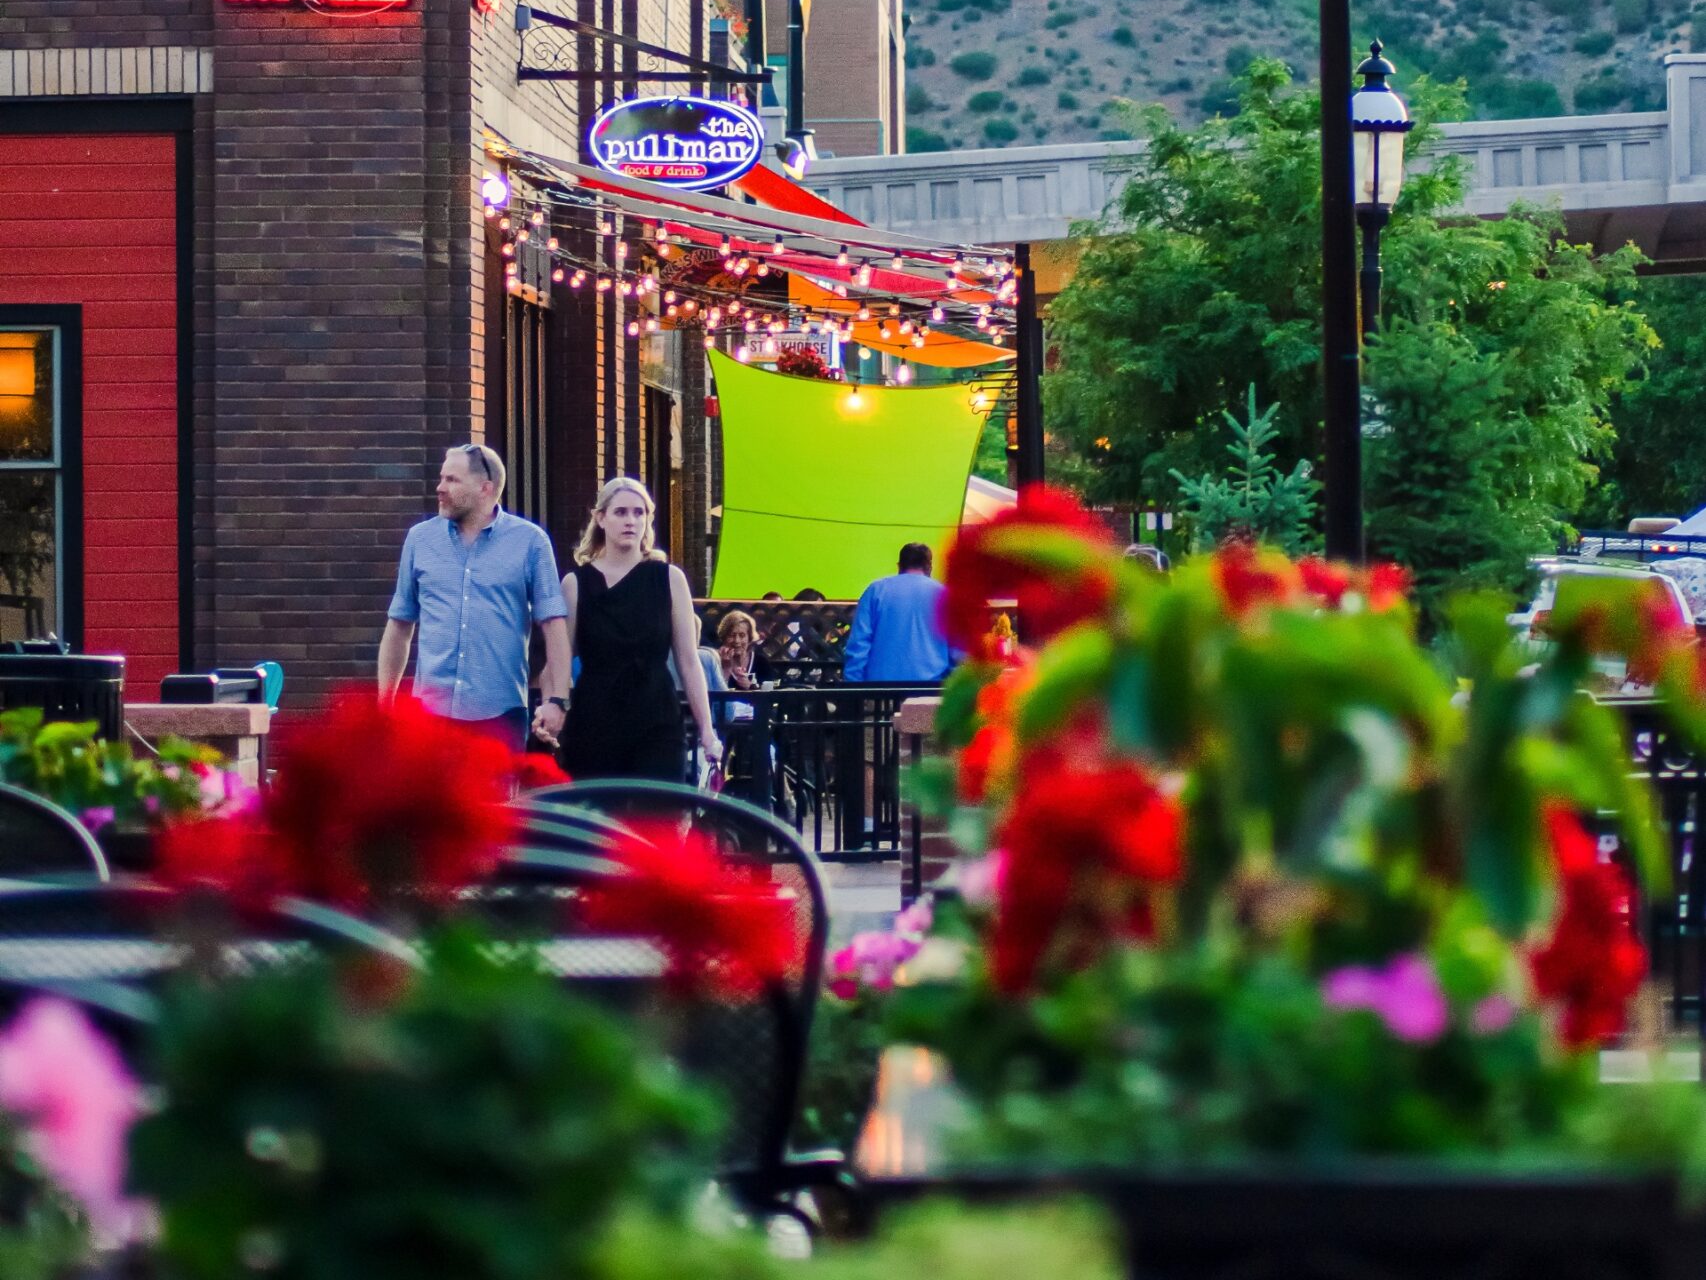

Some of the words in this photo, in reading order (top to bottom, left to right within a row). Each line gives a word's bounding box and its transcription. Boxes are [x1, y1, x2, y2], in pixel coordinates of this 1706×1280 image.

[706, 116, 752, 139] the
[603, 133, 752, 164] pullman
[623, 164, 650, 176] food
[653, 166, 664, 176] &
